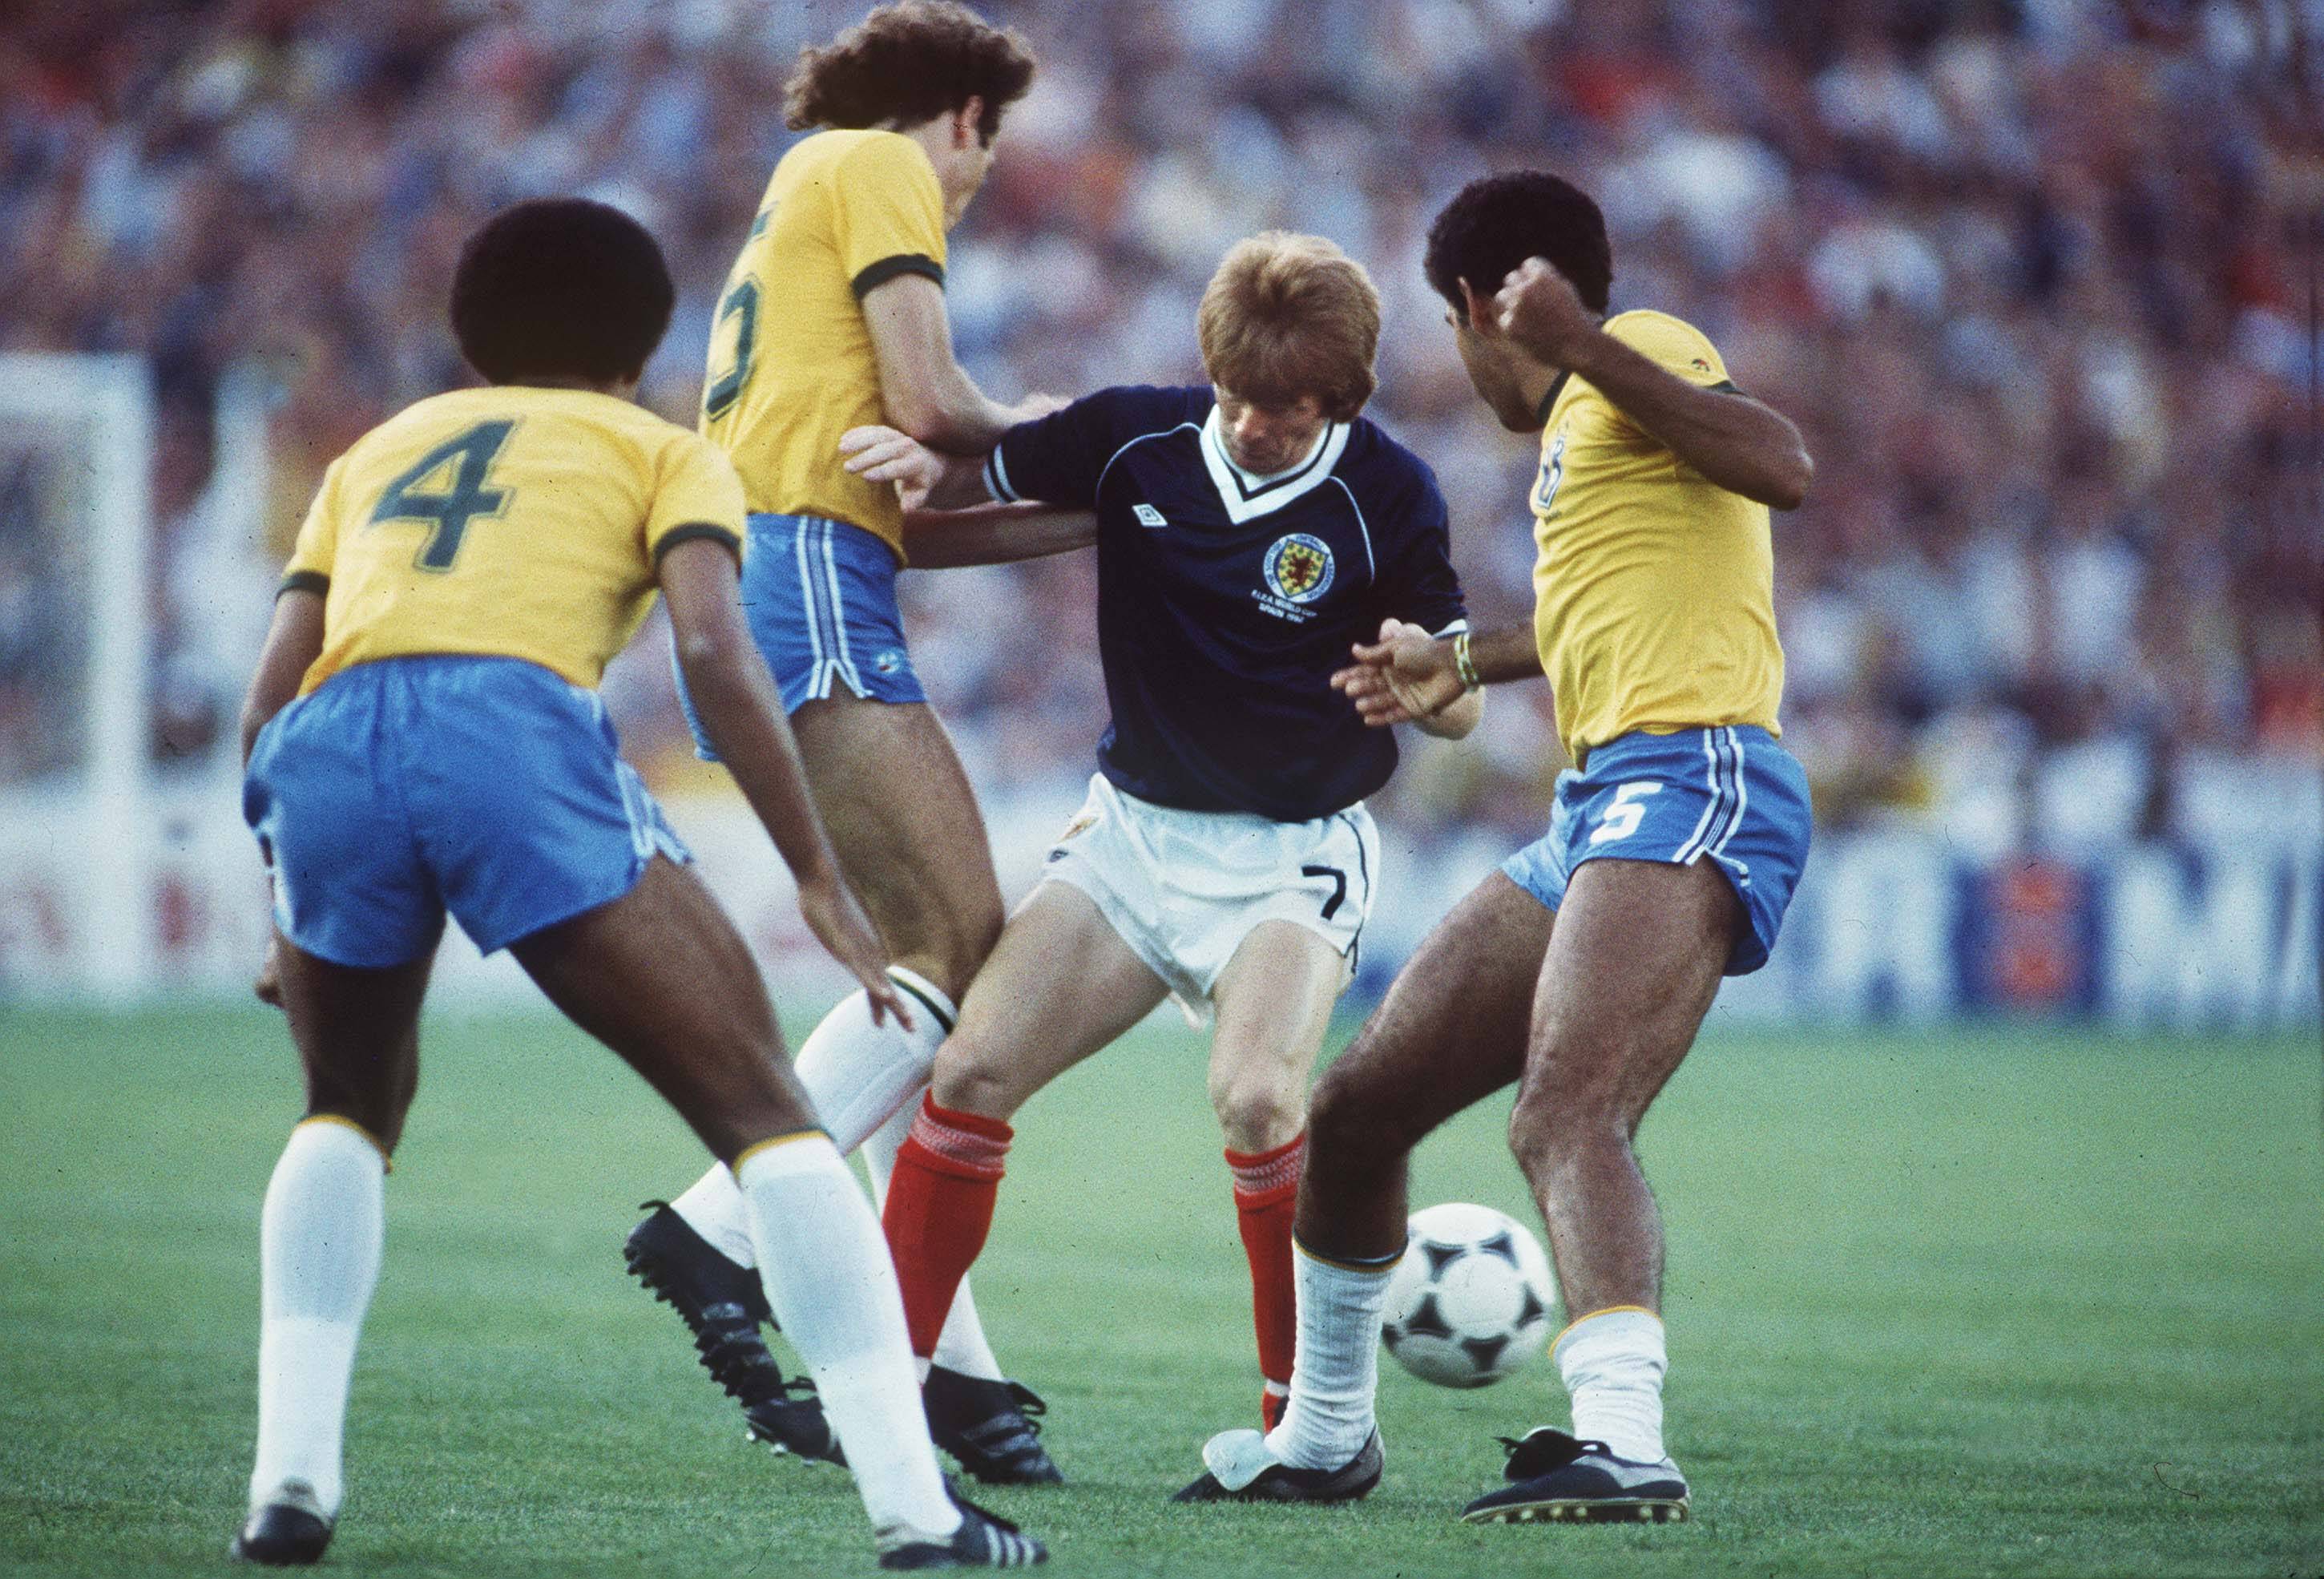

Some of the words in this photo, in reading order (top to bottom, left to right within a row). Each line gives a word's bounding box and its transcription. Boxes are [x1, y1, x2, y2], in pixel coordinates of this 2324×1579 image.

[366, 417, 518, 571] 4
[1590, 781, 1663, 844] 5
[1301, 865, 1347, 921] 7
